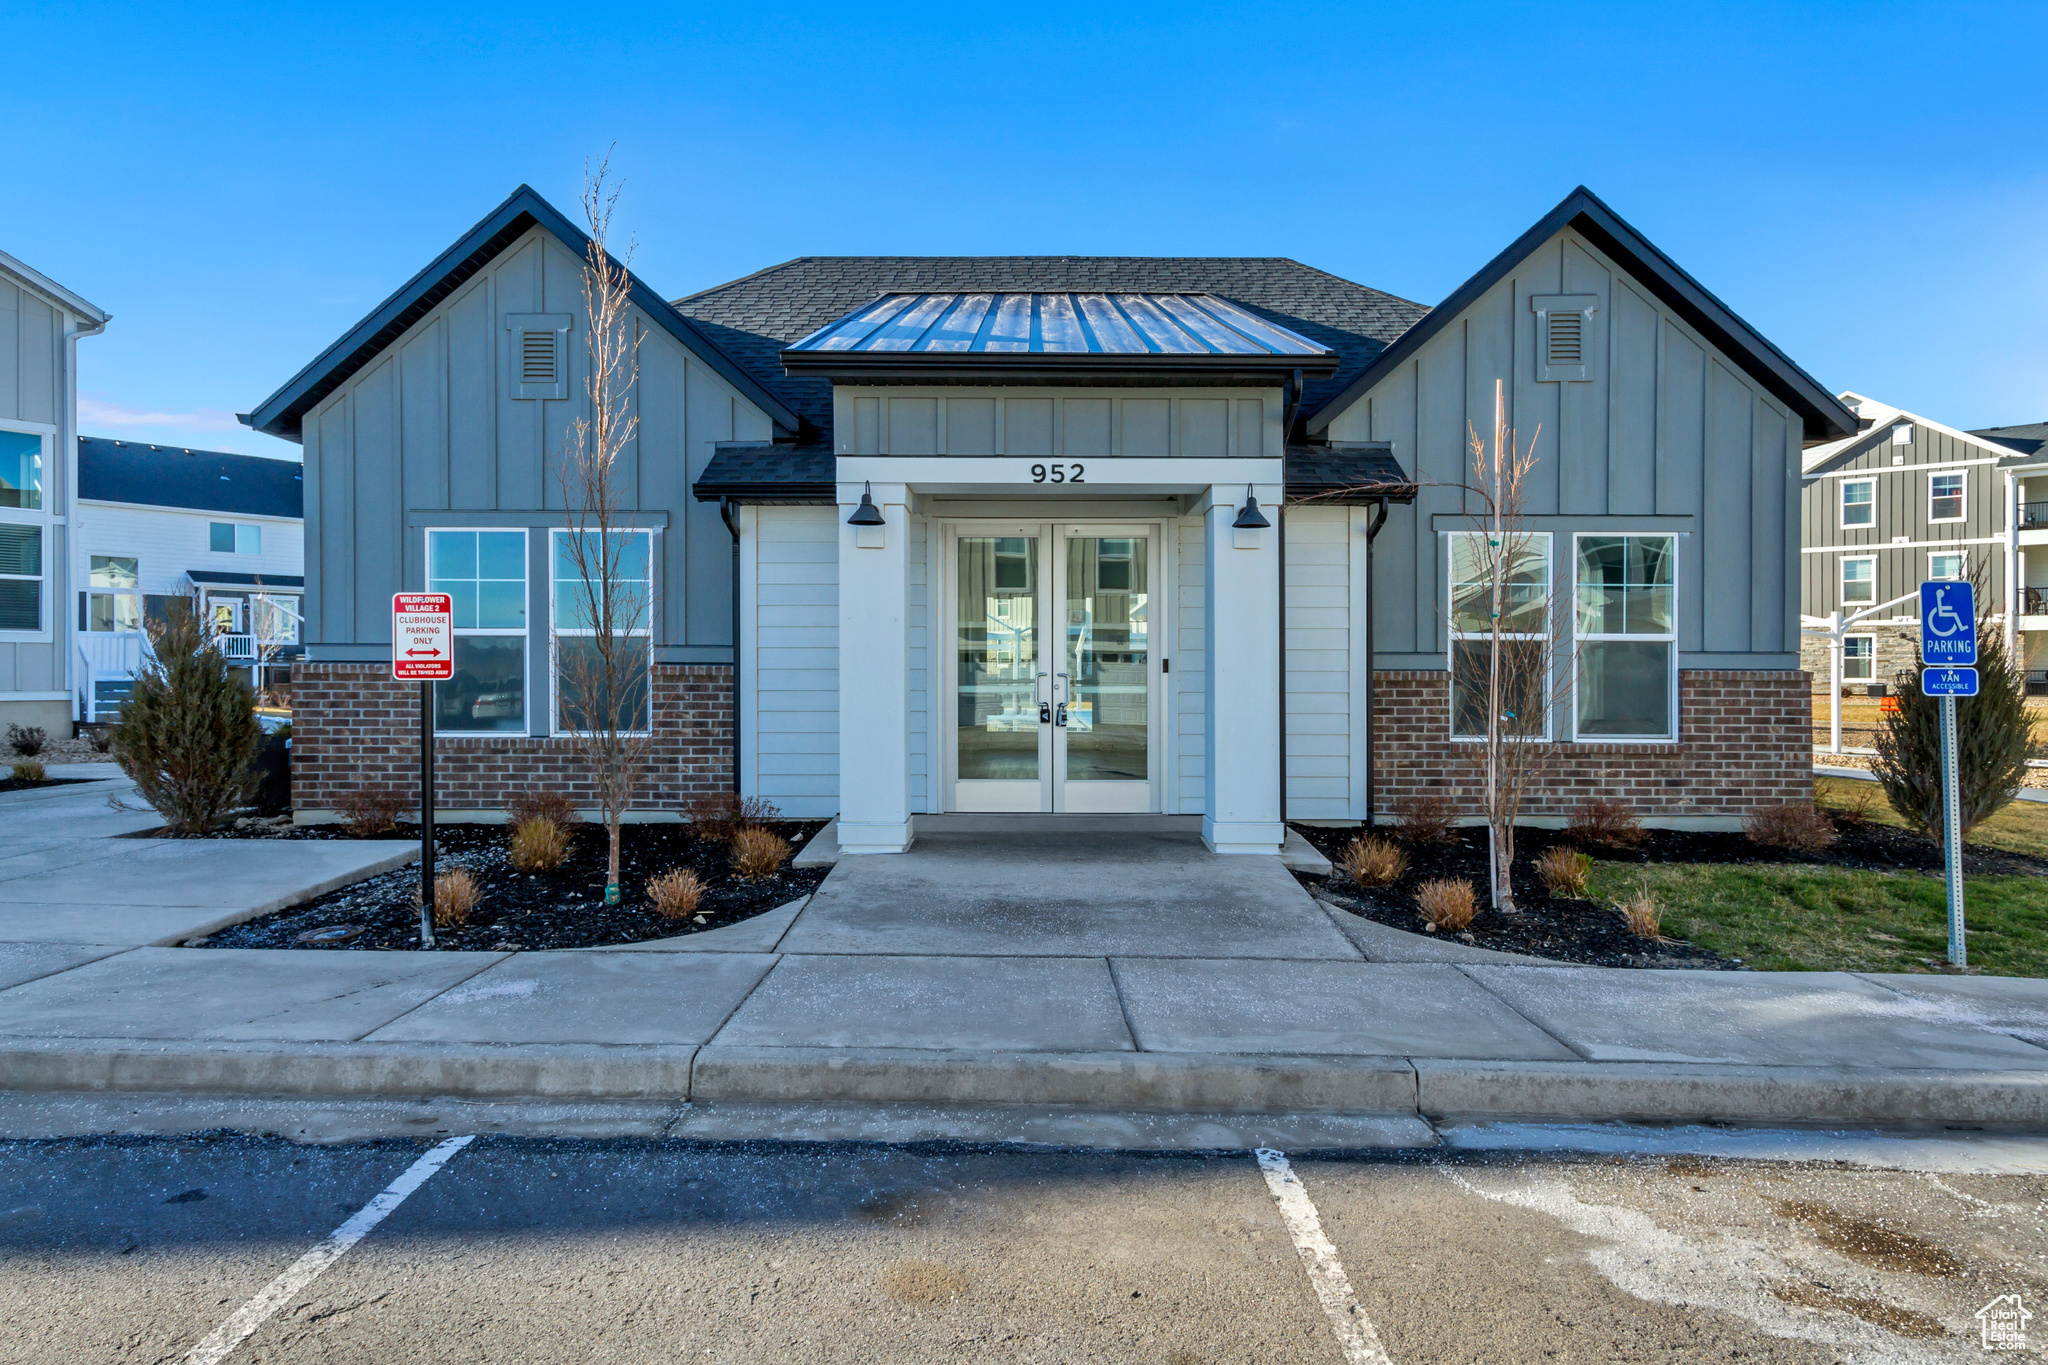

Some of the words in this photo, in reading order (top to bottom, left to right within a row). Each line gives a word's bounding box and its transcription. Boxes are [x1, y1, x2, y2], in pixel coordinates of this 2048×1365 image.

[1031, 463, 1085, 483] 952
[399, 616, 447, 624] CLUBHOUSE
[405, 626, 440, 634] PARKING
[413, 637, 433, 645] ONLY
[1927, 640, 1971, 653] PARKING
[1941, 674, 1960, 682] VAN
